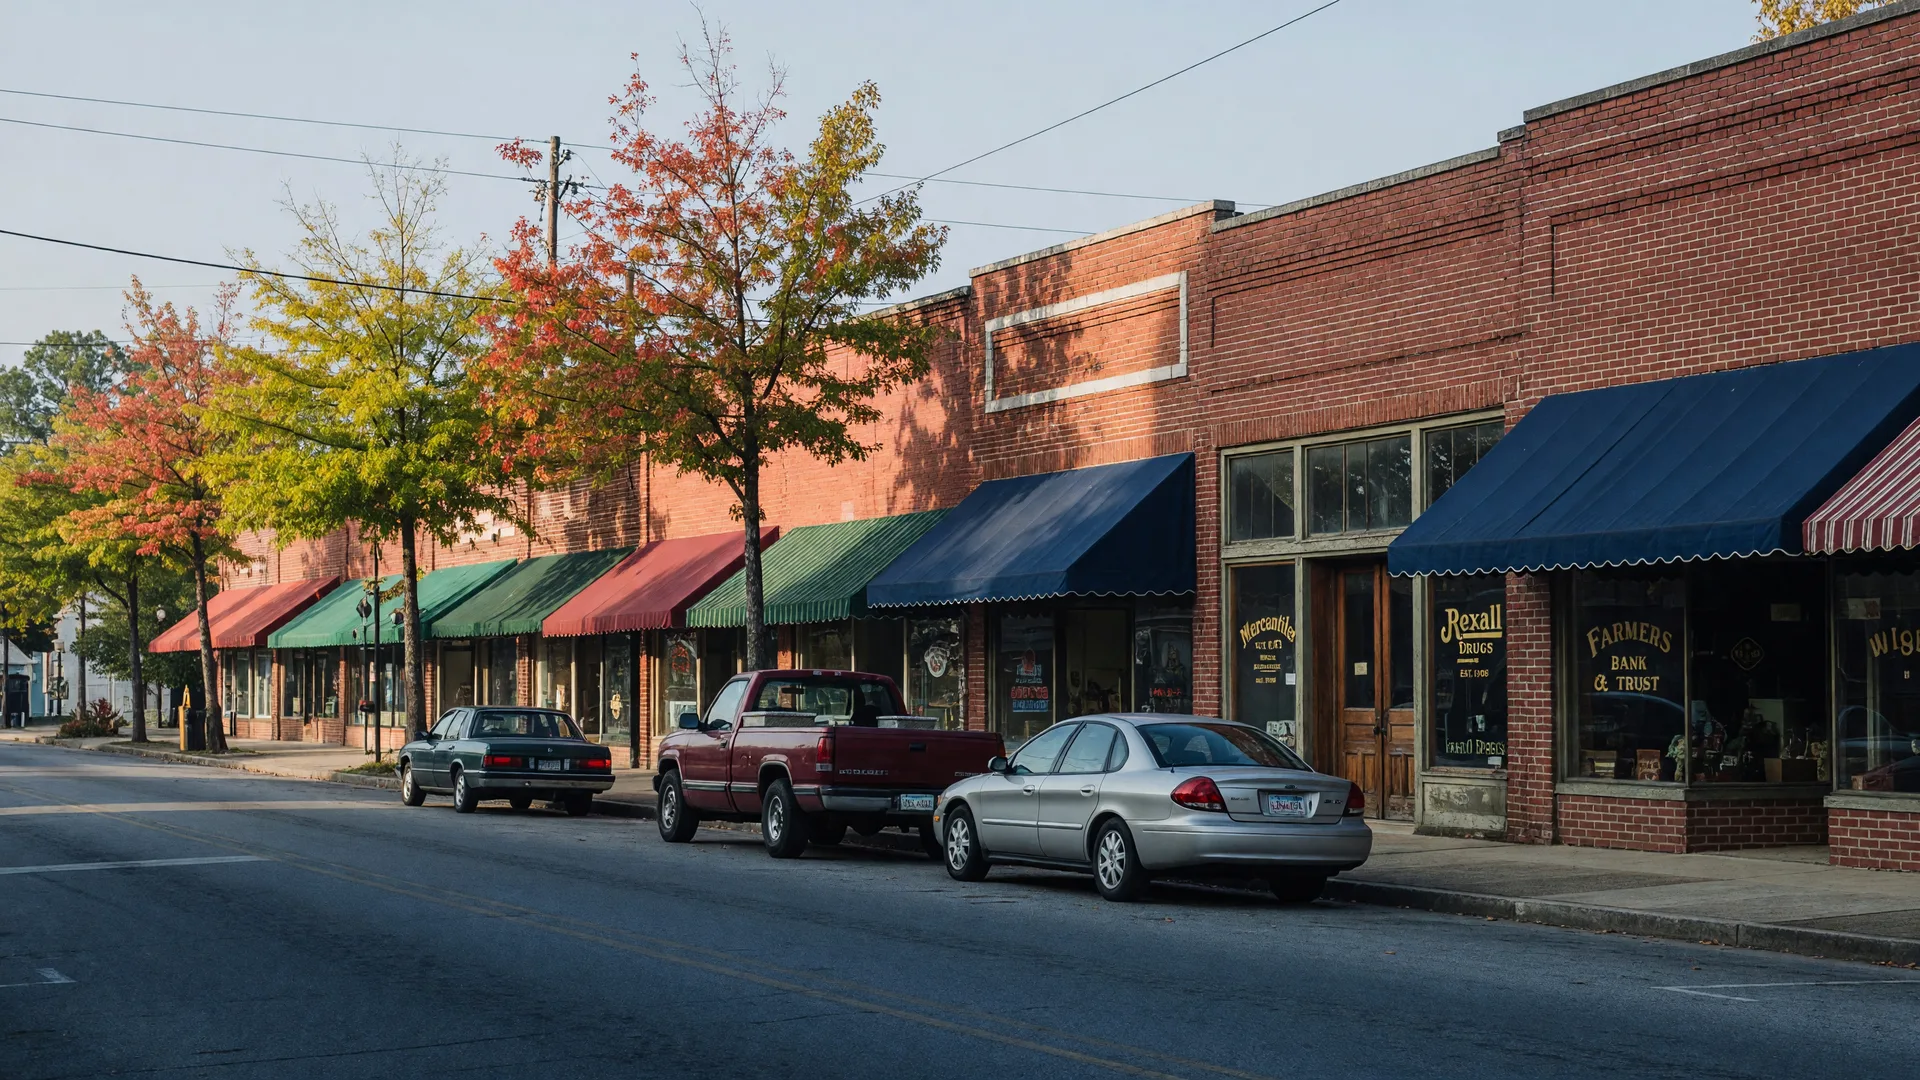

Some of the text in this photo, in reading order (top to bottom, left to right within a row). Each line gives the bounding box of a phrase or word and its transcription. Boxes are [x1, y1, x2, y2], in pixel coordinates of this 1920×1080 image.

[1440, 603, 1502, 644] Rexall
[1458, 641, 1494, 655] DRUGS
[1586, 620, 1673, 659] FARMERS
[1610, 655, 1647, 671] BANK
[1593, 673, 1660, 692] & TRUST
